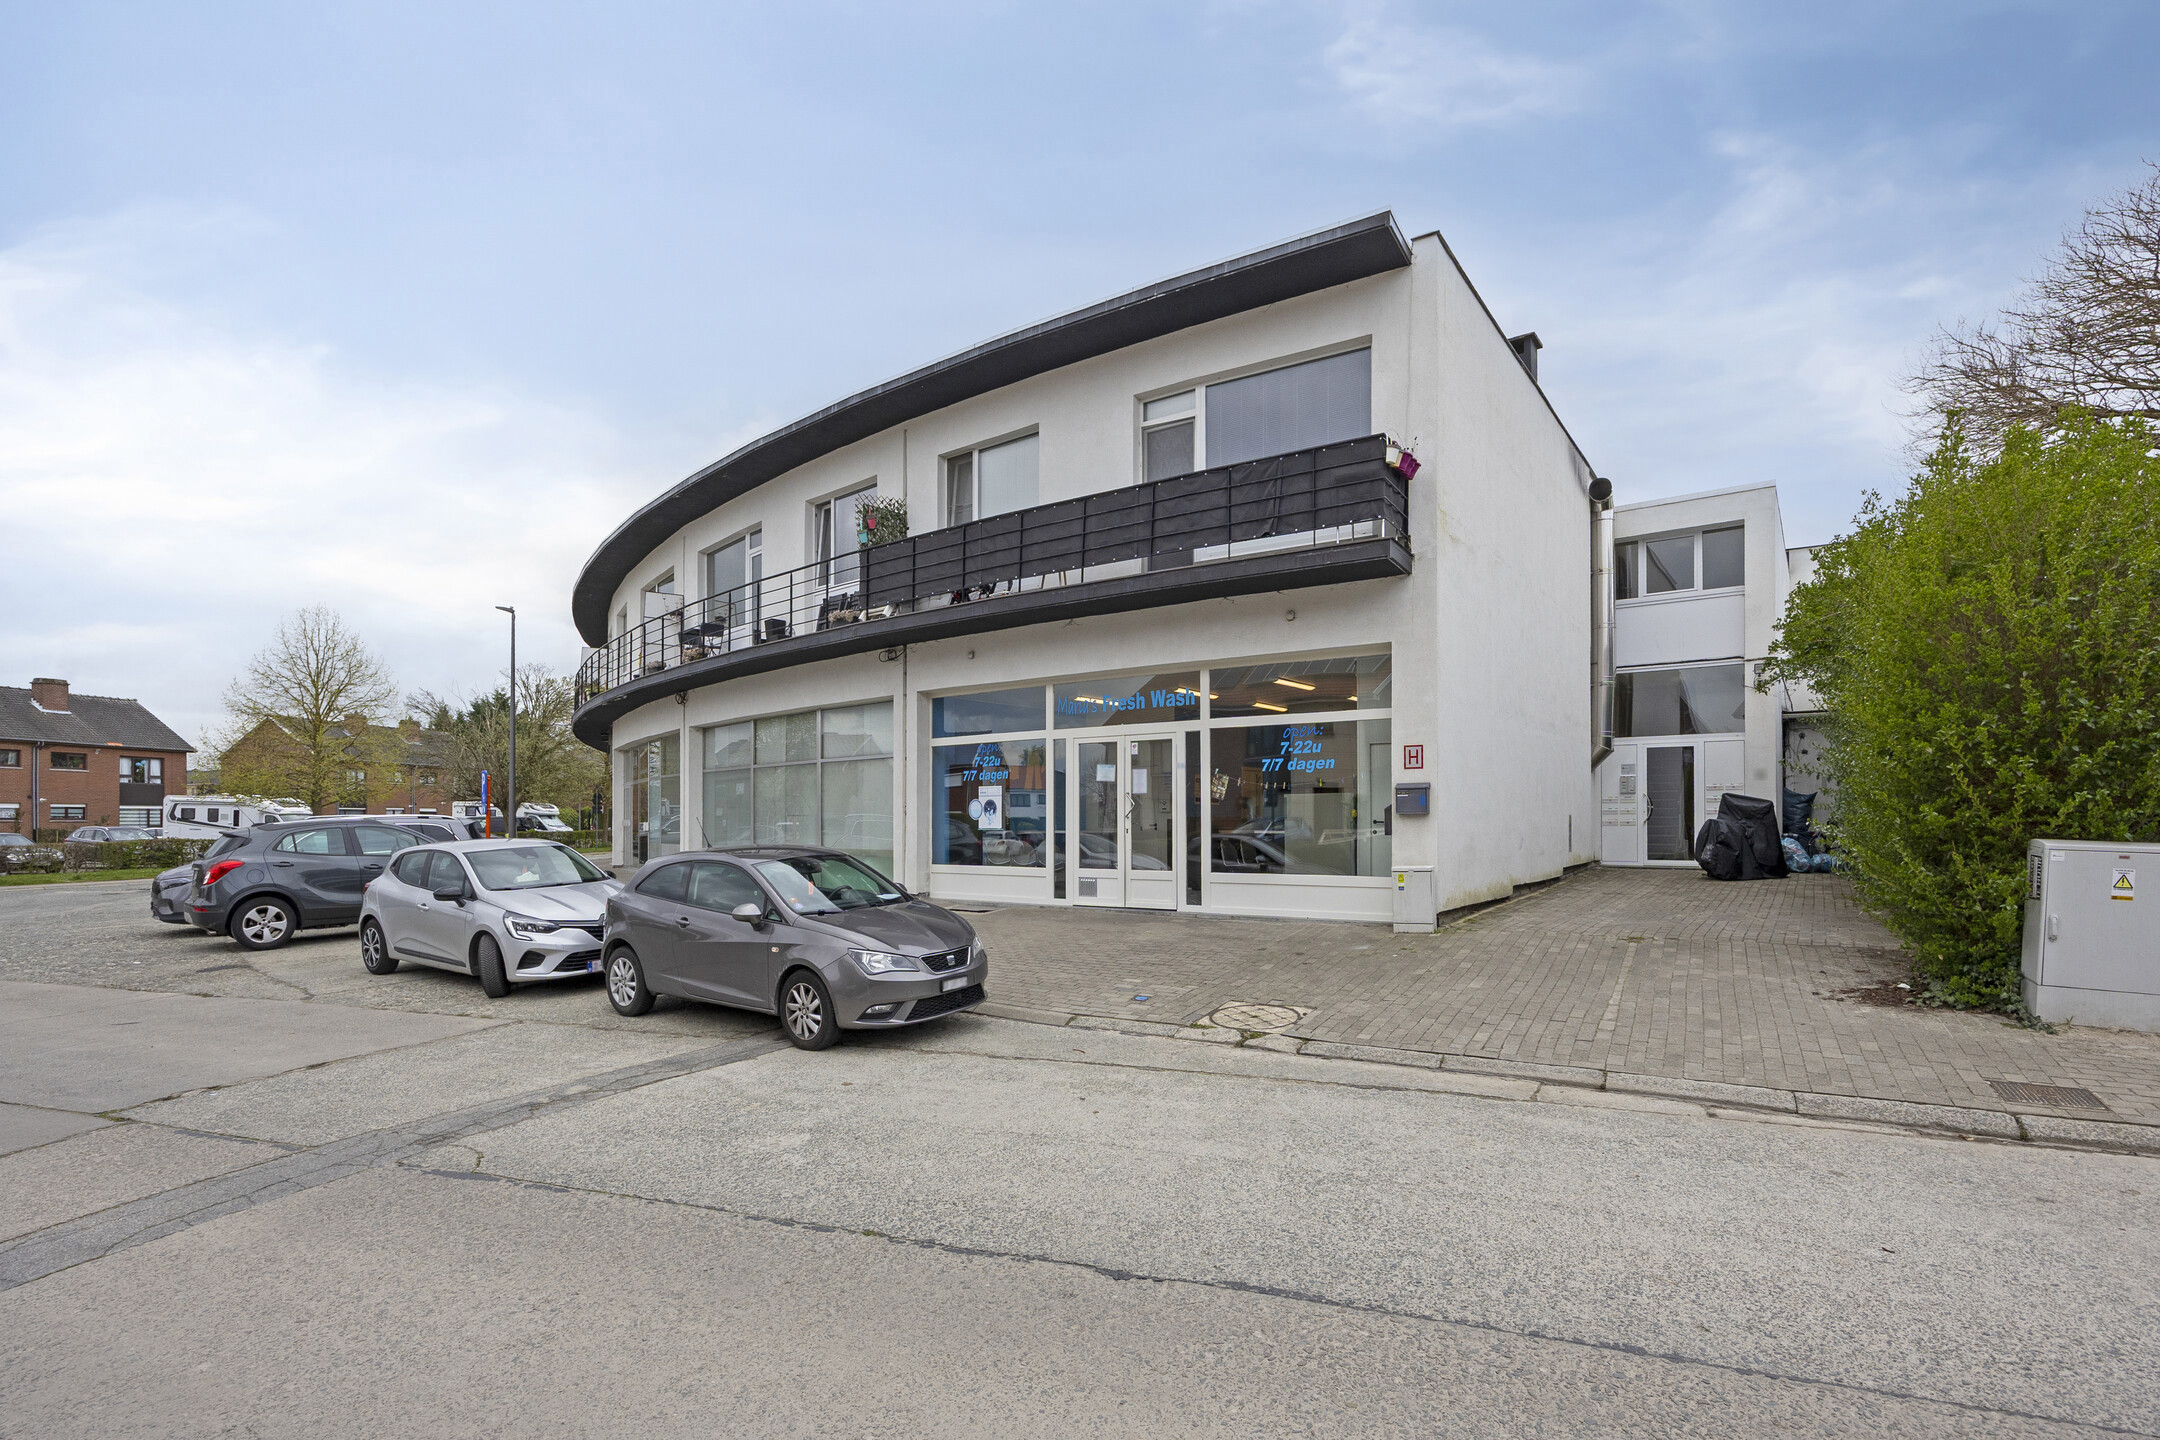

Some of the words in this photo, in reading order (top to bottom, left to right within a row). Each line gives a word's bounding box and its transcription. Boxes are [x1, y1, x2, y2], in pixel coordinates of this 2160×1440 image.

[1057, 695, 1098, 716] Maria's
[1102, 692, 1145, 712] Fresh
[1151, 687, 1196, 708] Wash
[1283, 725, 1324, 744] open:
[1280, 740, 1322, 755] 7-22u
[975, 755, 1001, 768] 7-22u
[1261, 758, 1284, 772] 7/7
[1287, 757, 1335, 773] dagen
[1408, 749, 1419, 765] H
[963, 770, 977, 782] 7/7
[978, 769, 1009, 783] dagen
